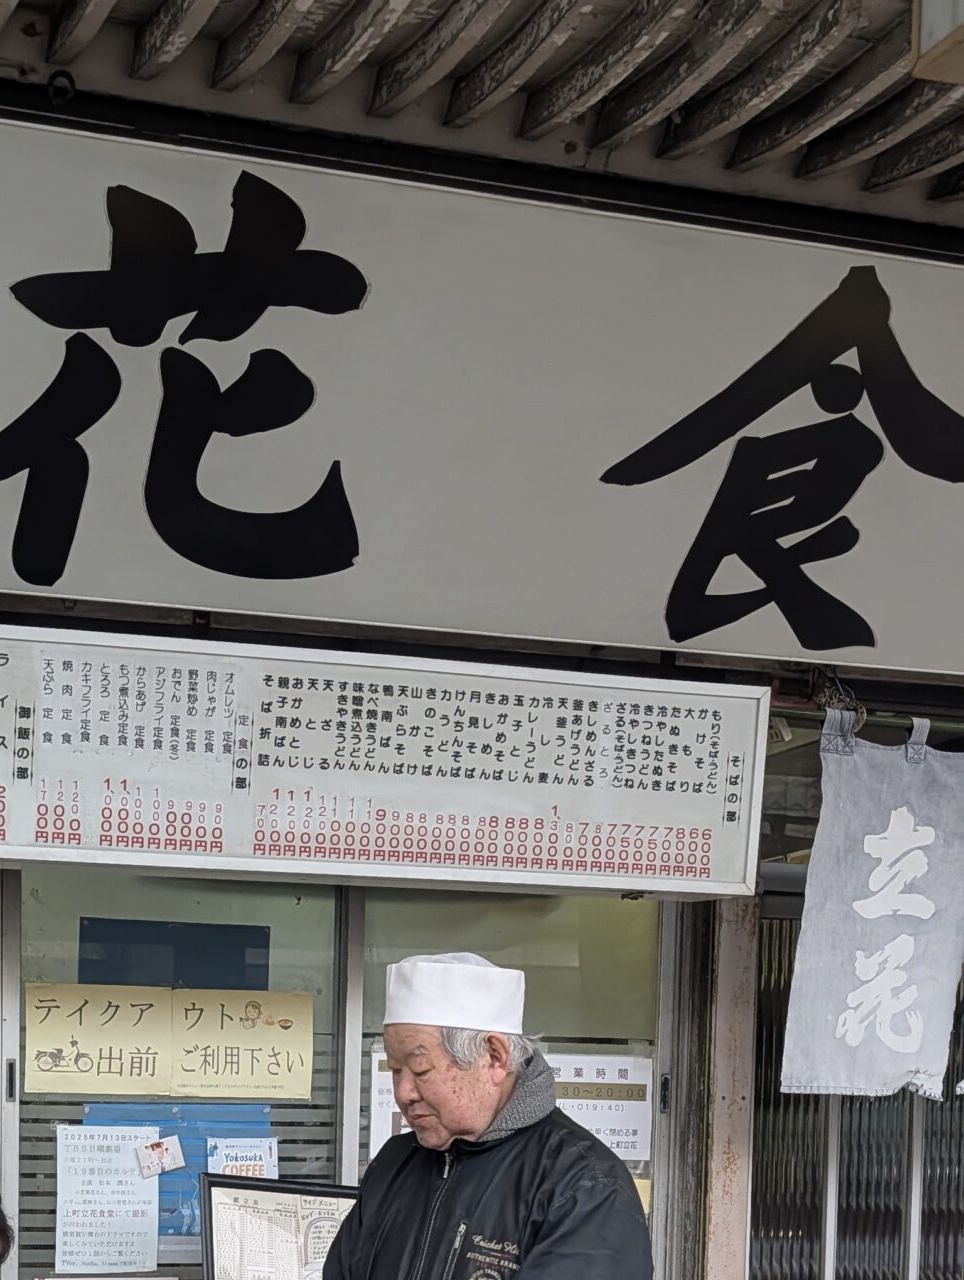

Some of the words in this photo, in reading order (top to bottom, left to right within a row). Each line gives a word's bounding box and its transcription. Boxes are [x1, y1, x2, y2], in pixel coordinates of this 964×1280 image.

[16, 706, 31, 780] 御飯の部
[235, 715, 249, 789] 定食の部
[257, 674, 275, 767] そば折詰
[272, 676, 290, 768] 親子南ばん
[288, 677, 304, 769] おかめとじ
[303, 678, 319, 769] 天とじ
[318, 679, 334, 770] 天ざる
[333, 681, 349, 770] すきやきうどん
[363, 683, 380, 772] なべ焼きうどん
[378, 684, 394, 773] 鴨南ばん
[393, 685, 409, 774] 天ぷらそば
[407, 686, 422, 775] 山かけ
[421, 687, 437, 776] きのこそば
[450, 689, 466, 778] けんちんそば
[464, 690, 481, 779] 月見そば
[479, 692, 496, 780] きしめん
[492, 694, 509, 781] おかめそば
[507, 694, 524, 782] 玉子とじ
[523, 696, 540, 784] カレーうどん
[583, 700, 599, 787] きしめんざる
[624, 703, 640, 789] 冷やしきつね
[637, 704, 654, 791] きつねうどん
[651, 705, 668, 792] 冷やしたぬき
[665, 706, 681, 792] たぬきそば
[679, 708, 695, 793] 大もり
[692, 709, 709, 794] かけそば
[726, 756, 741, 822] そばの部
[96, 1046, 158, 1077] 出前
[180, 1044, 304, 1077] ご利用下さい
[222, 1164, 265, 1176] COFFEE
